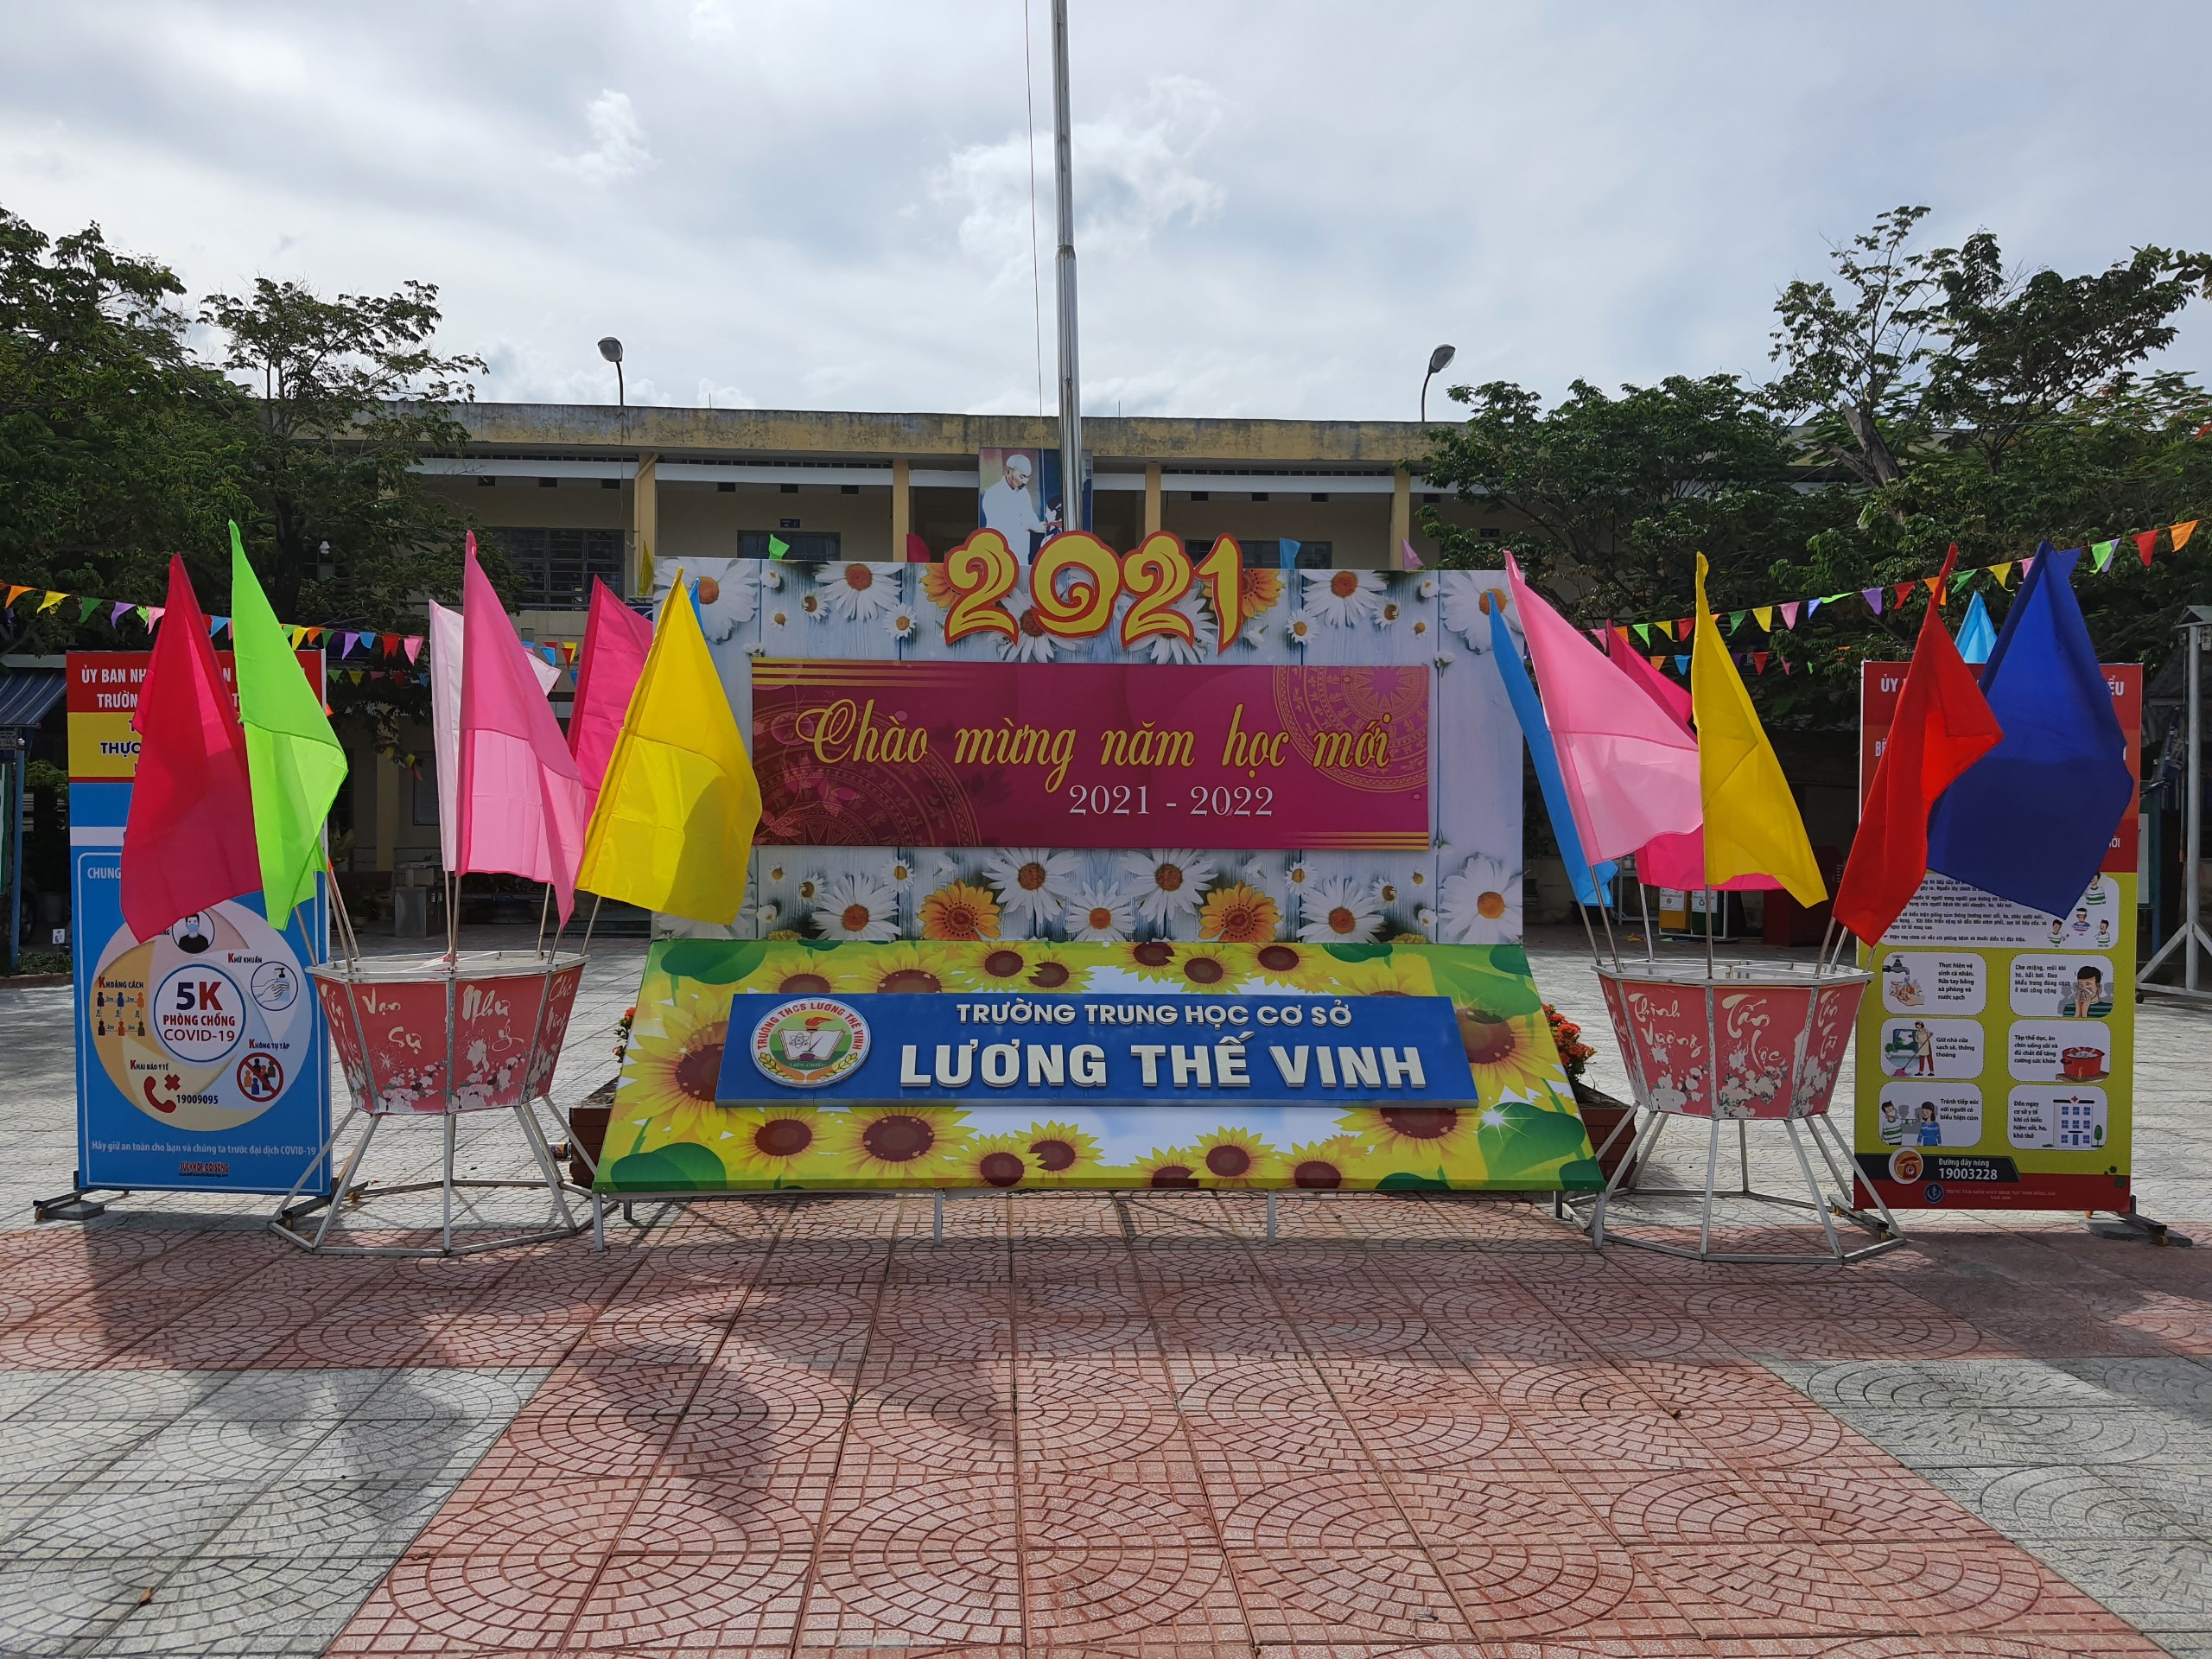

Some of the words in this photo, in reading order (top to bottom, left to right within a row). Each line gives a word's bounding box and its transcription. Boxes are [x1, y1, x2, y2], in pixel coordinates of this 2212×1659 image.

[944, 528, 1243, 655] 2021
[81, 664, 97, 683] ỦY
[101, 668, 125, 683] BAN
[1880, 673, 1899, 693] ỦY
[97, 690, 138, 709] TRƯỜN
[796, 698, 928, 765] Chào
[954, 717, 1077, 793] mừng
[1100, 720, 1195, 767] năm
[1221, 703, 1290, 779] học
[1313, 713, 1392, 768] mới
[1069, 785, 1150, 817] 2021
[1190, 786, 1274, 817] 2022
[87, 867, 121, 880] CHUNG
[175, 981, 223, 1011] 5K
[162, 1013, 198, 1027] PHÒNG
[200, 1012, 236, 1027] CHỐNG
[956, 997, 1076, 1025] TRƯỜNG
[1084, 1003, 1178, 1025] TRUNG
[1185, 1005, 1249, 1030] HỌC
[1256, 1004, 1303, 1027] CƠ
[1311, 999, 1351, 1027] SỞ
[163, 1028, 236, 1042] COVID-19
[778, 1003, 806, 1018] THCS
[852, 1029, 864, 1050] VINH
[900, 1039, 1107, 1088] LƯƠNG
[1131, 1031, 1255, 1088] THẾ
[1268, 1045, 1426, 1089] VINH
[176, 1094, 219, 1104] 19009095
[92, 1141, 106, 1151] Hãy
[152, 1142, 165, 1152] cho
[167, 1143, 181, 1154] bạn
[280, 1146, 316, 1156] COVID-19
[1938, 1157, 1960, 1166] Đường
[1961, 1158, 1972, 1167] dây
[1973, 1159, 1989, 1167] nóng
[1938, 1168, 1998, 1180] 19003228
